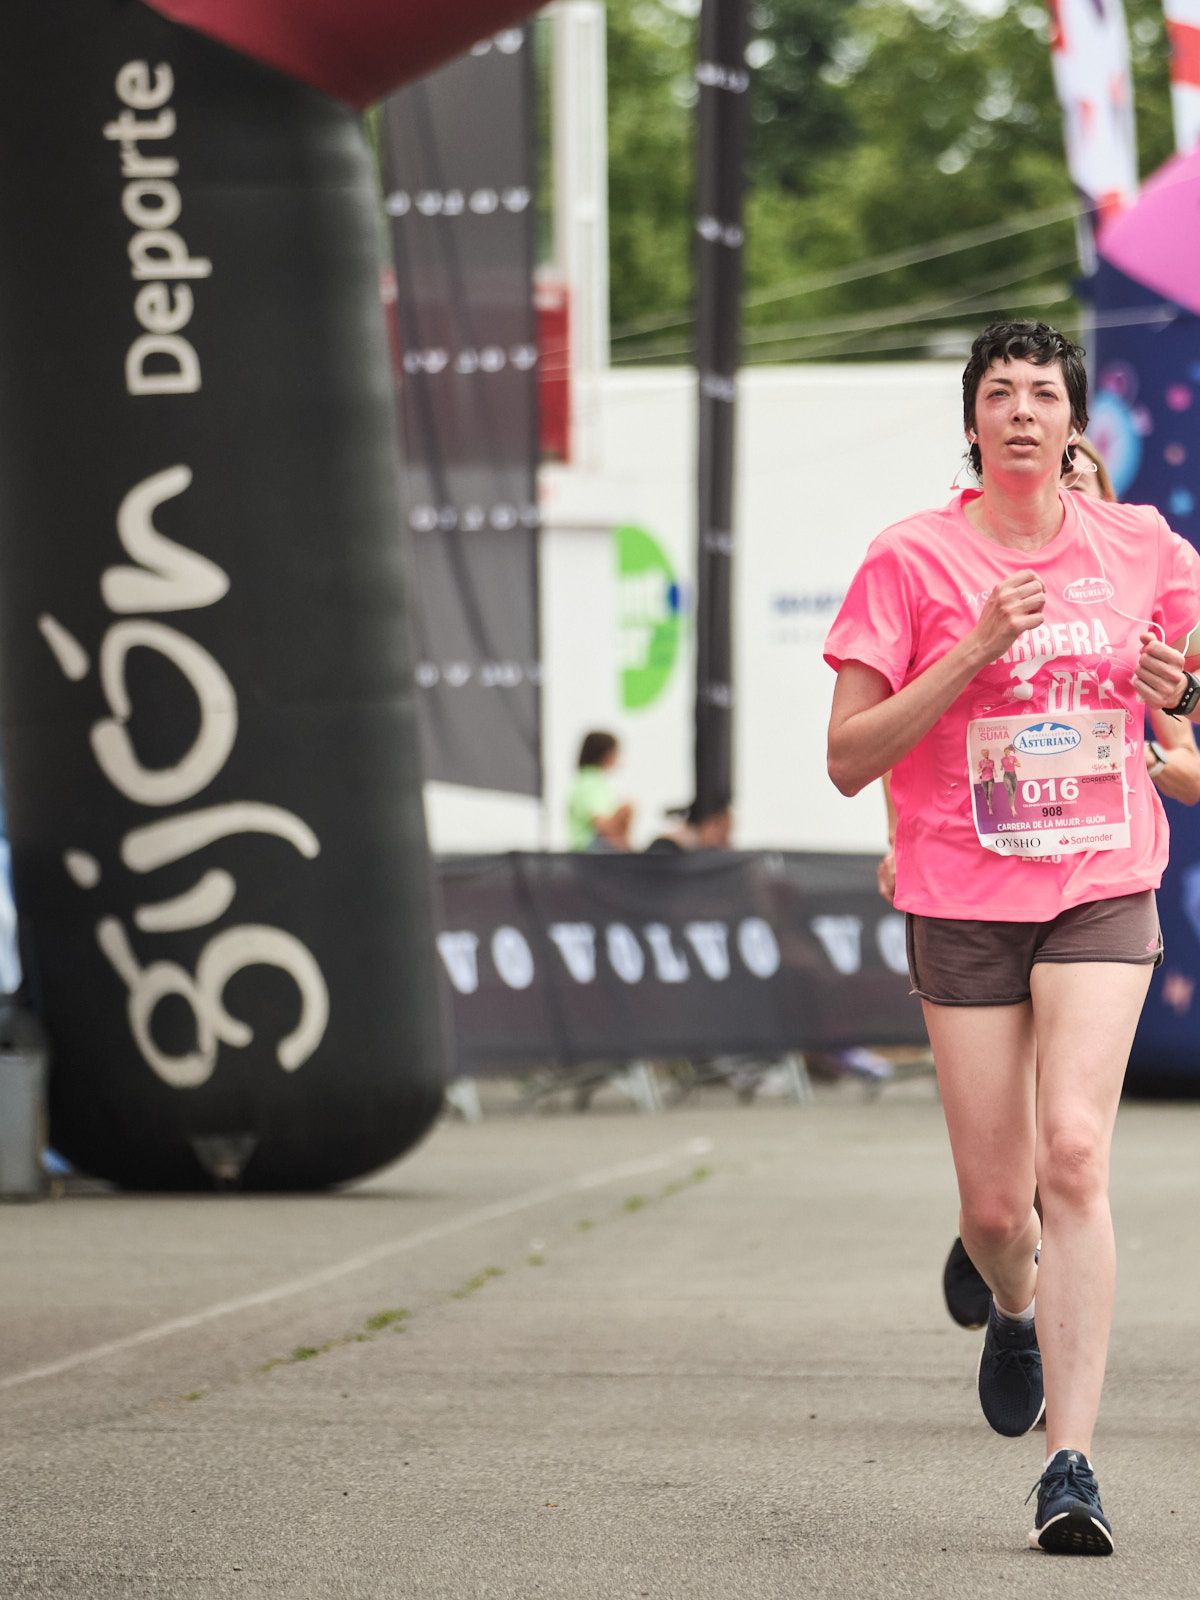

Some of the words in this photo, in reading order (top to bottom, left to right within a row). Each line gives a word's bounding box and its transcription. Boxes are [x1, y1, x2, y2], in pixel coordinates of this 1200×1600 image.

[103, 59, 212, 396] Deporte
[980, 731, 1010, 741] SUMA
[1019, 736, 1077, 749] ASTURIANA
[1022, 777, 1080, 804] 016
[1042, 806, 1062, 817] 908
[997, 820, 1031, 832] CARRERA
[1033, 820, 1042, 829] DE
[1043, 819, 1053, 828] LA
[1055, 817, 1080, 828] MUJER
[995, 837, 1041, 849] OYSHO
[1070, 833, 1113, 845] Santander
[548, 916, 781, 985] VOLVO
